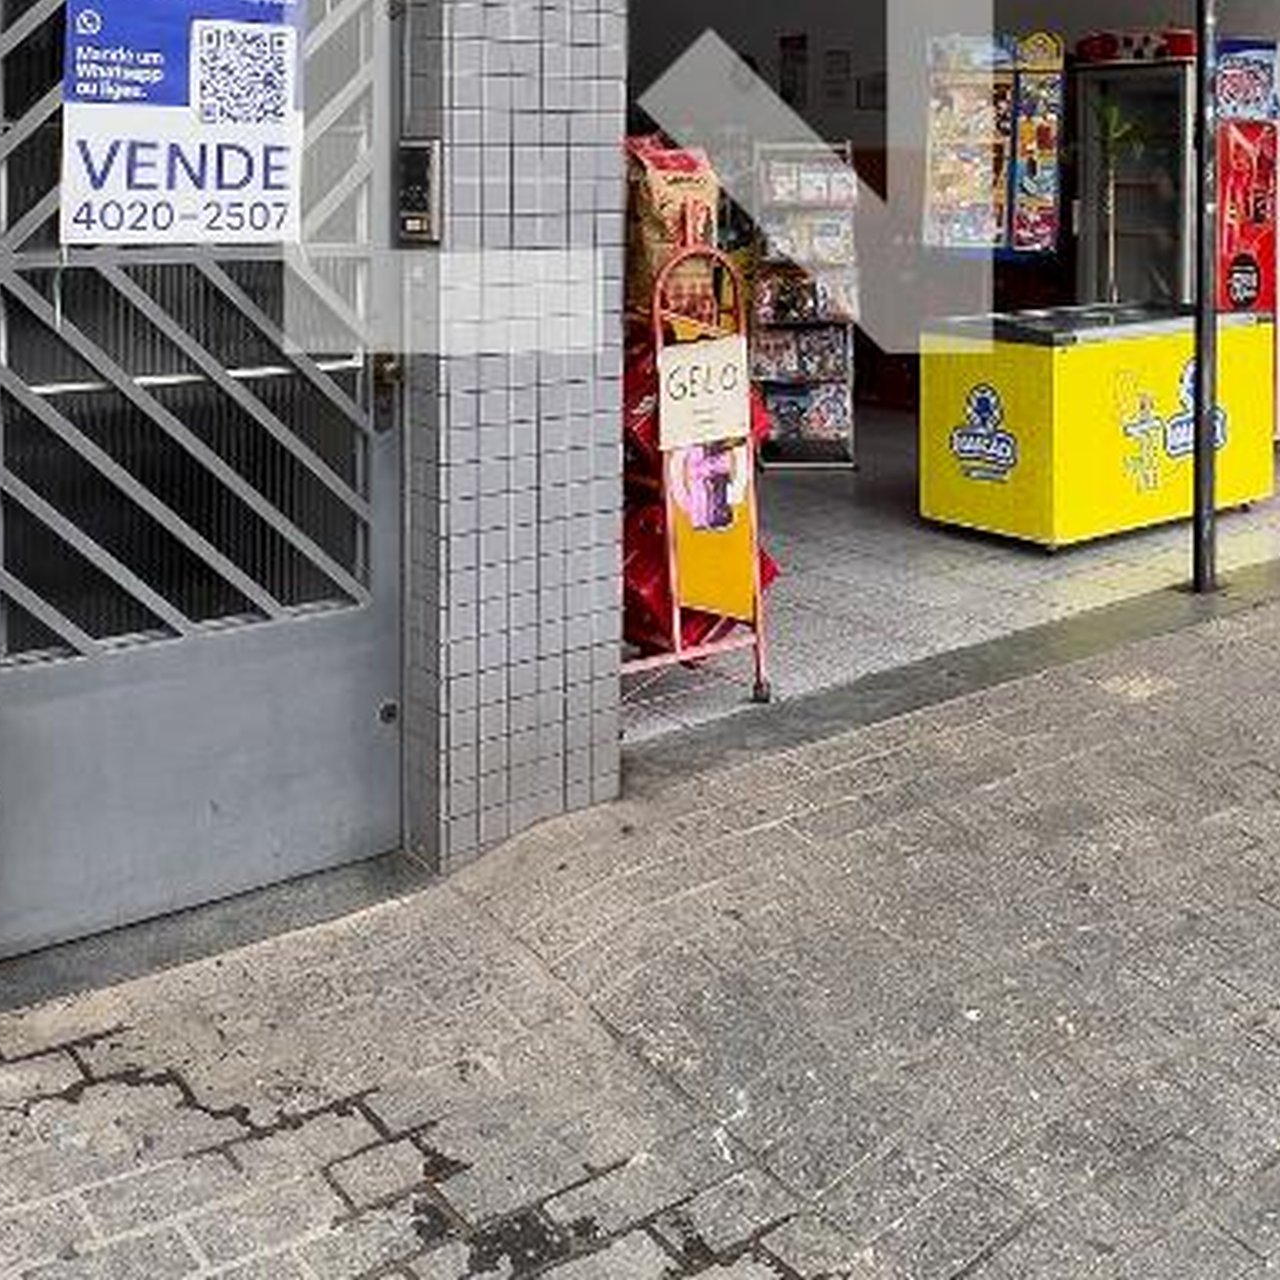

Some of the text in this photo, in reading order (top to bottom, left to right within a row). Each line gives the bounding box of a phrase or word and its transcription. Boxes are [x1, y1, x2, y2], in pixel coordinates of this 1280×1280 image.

[75, 81, 98, 95] ou
[76, 139, 291, 192] VENDE
[72, 200, 290, 232] 4020-2507
[666, 363, 738, 402] GELO
